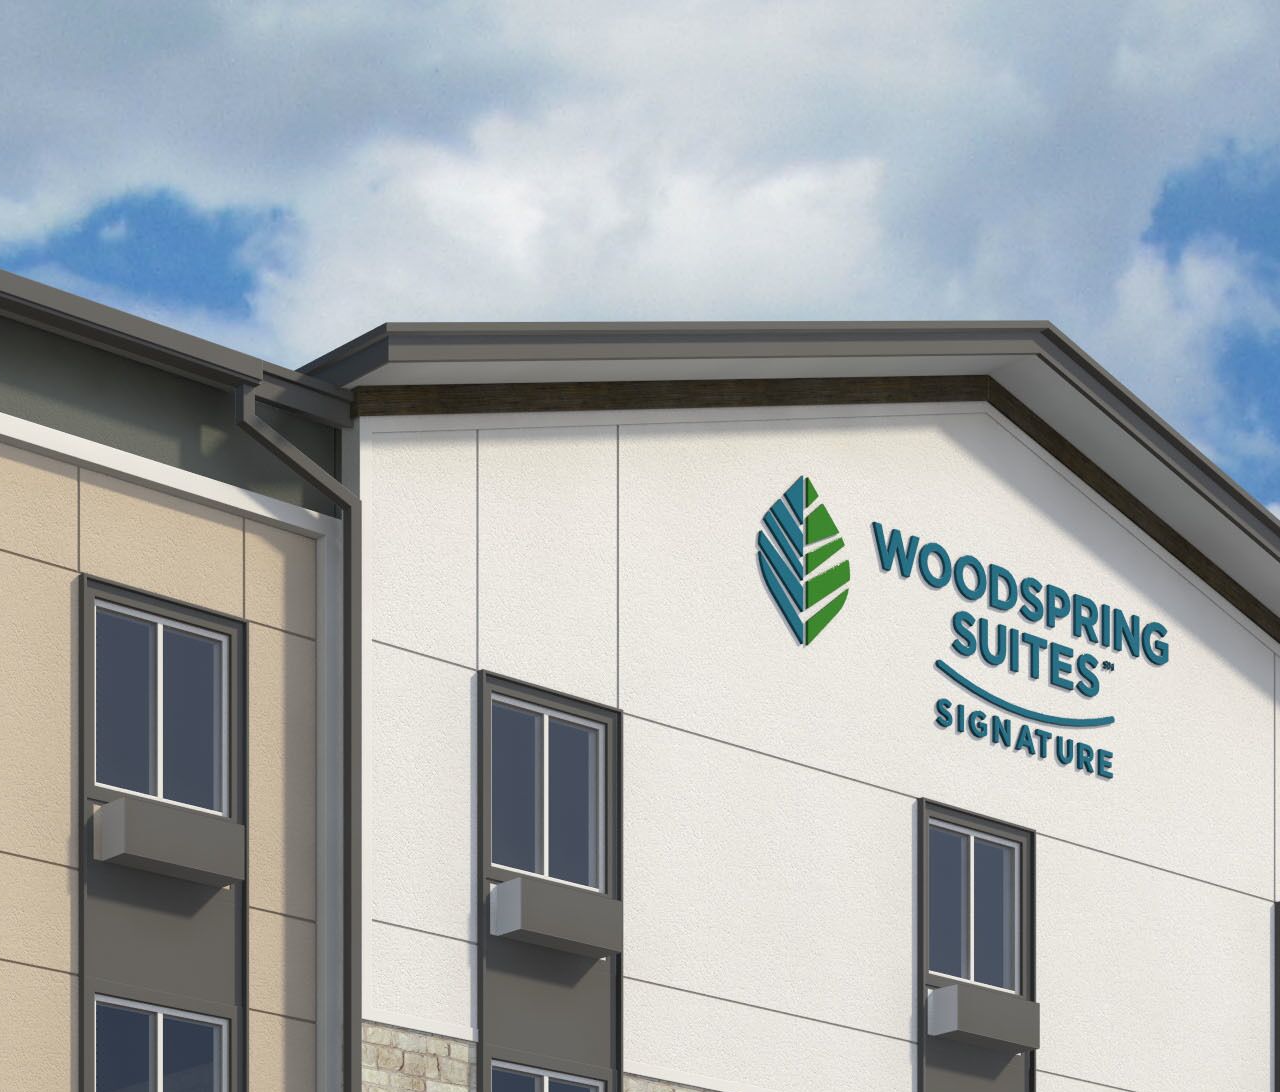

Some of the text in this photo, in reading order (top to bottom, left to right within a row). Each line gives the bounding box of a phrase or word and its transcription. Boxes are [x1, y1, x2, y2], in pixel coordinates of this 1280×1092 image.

[871, 521, 1169, 667] WOODSPRING
[951, 610, 1101, 699] SUITES
[934, 697, 1115, 780] SIGNATURE
